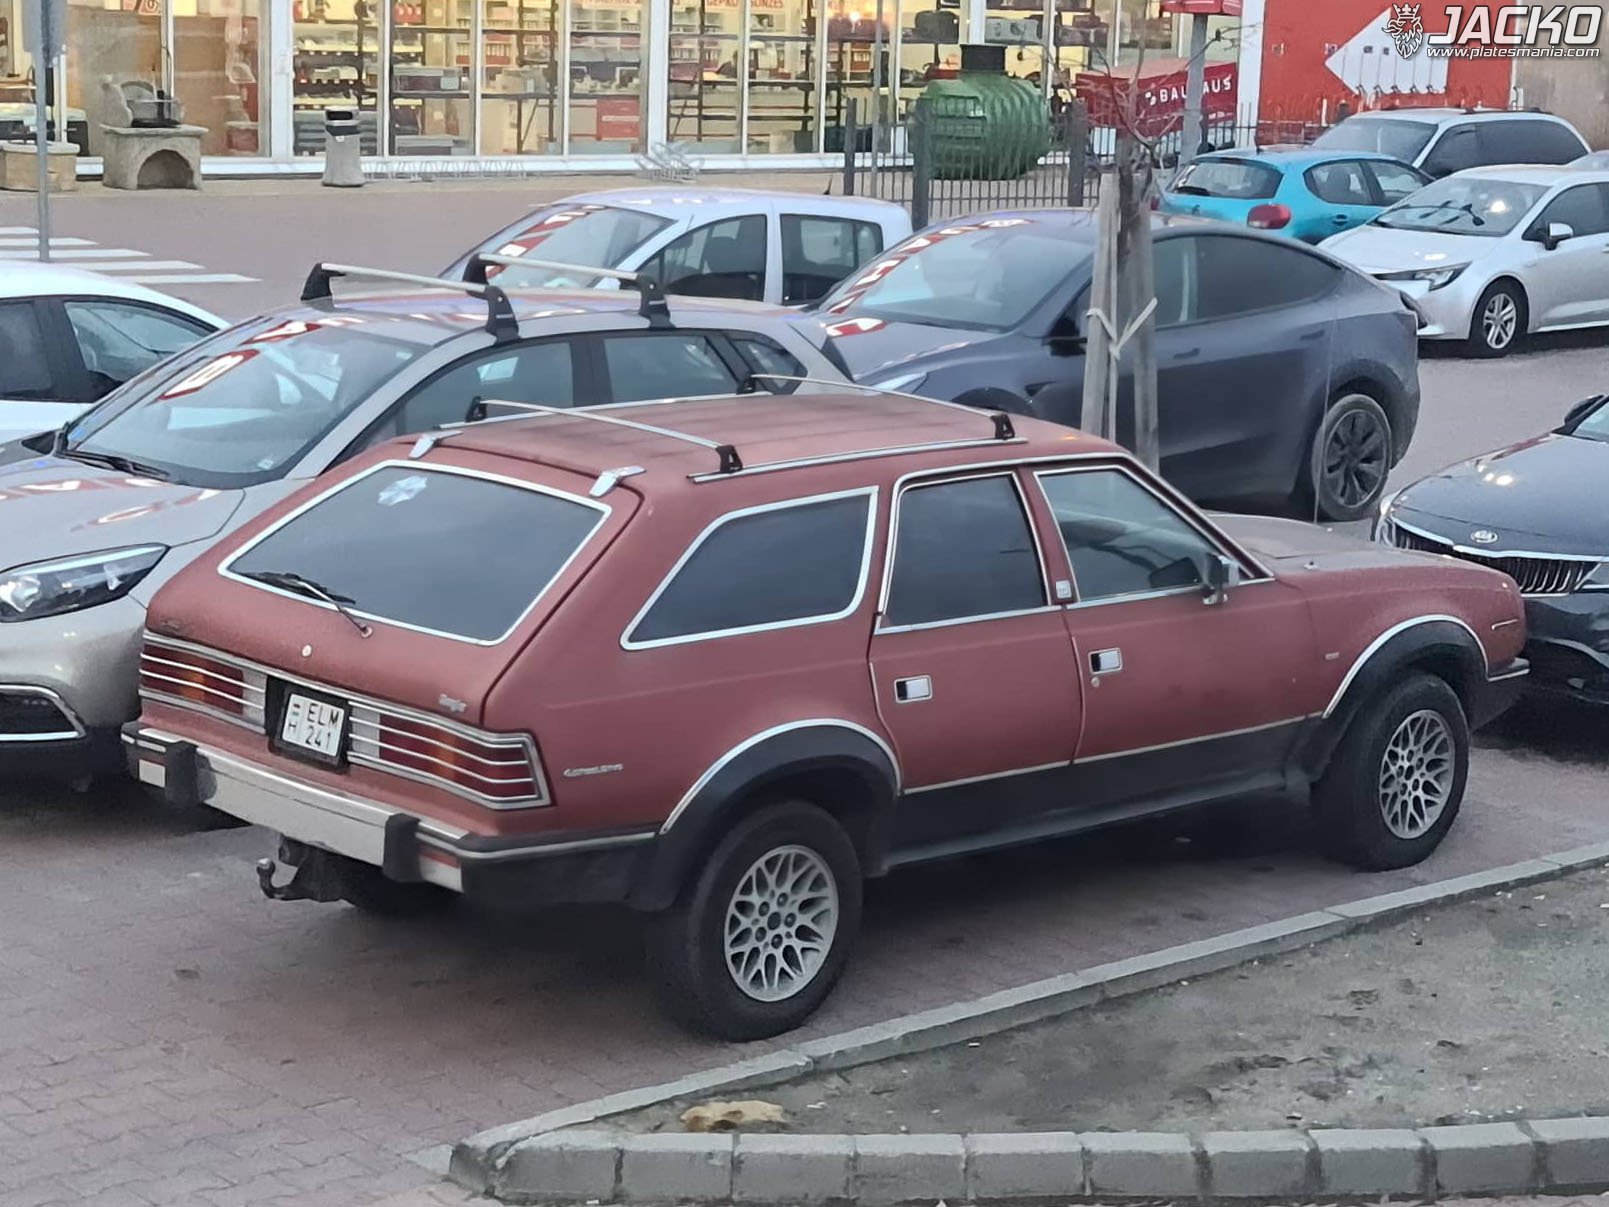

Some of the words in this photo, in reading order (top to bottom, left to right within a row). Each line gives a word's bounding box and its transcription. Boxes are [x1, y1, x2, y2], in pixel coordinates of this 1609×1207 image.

[1159, 76, 1232, 103] BAUAUS
[307, 702, 340, 728] ELM
[288, 721, 298, 736] H
[305, 725, 331, 750] 241
